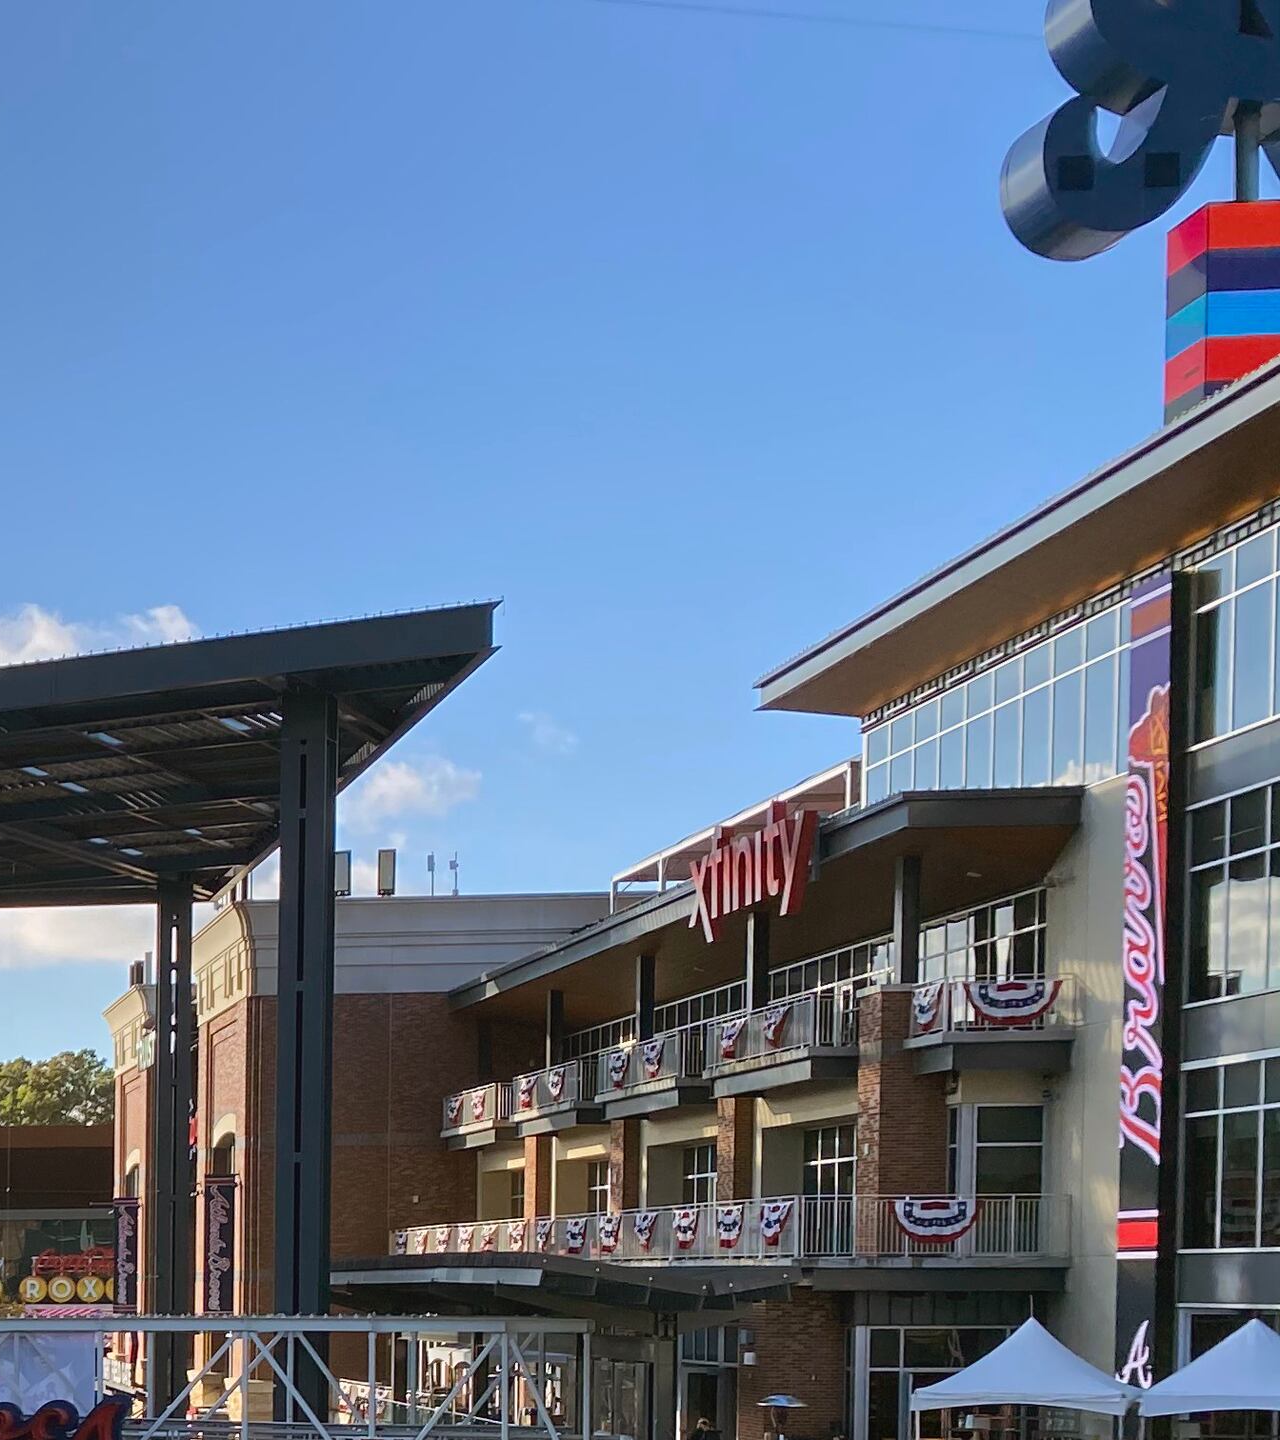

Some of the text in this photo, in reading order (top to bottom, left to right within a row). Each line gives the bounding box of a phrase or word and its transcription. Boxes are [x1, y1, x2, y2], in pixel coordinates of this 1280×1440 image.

[688, 800, 810, 943] xfinity
[1118, 767, 1162, 1164] Braves
[208, 1185, 230, 1310] Atlanta Braves
[1115, 1319, 1153, 1388] A
